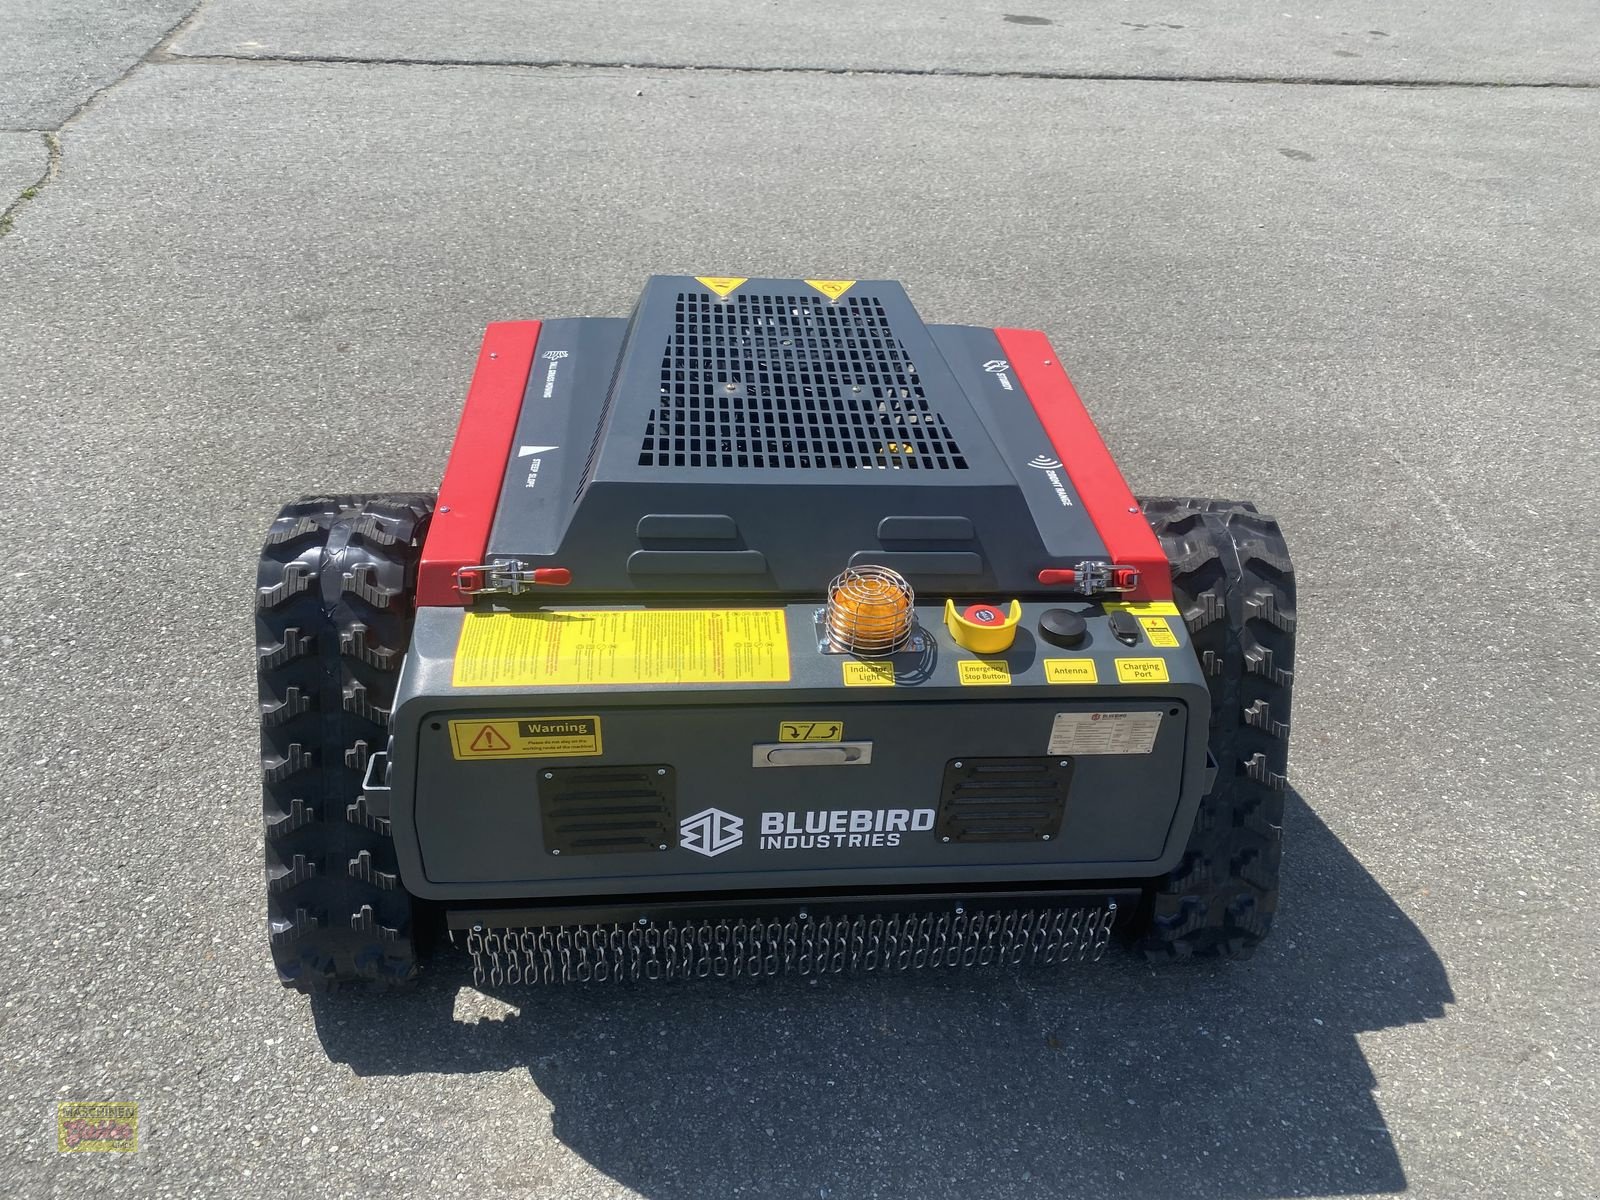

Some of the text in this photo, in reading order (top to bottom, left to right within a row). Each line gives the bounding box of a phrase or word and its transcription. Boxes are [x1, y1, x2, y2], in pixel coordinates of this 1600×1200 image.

[525, 458, 541, 488] STEEP SLOPE
[1055, 487, 1073, 506] RANGE
[850, 666, 887, 674] Indicator
[964, 666, 1004, 674] Emergency
[1054, 667, 1088, 675] Antenna
[1123, 663, 1160, 671] Charging
[859, 673, 881, 682] Light
[528, 722, 588, 734] Warning
[760, 808, 936, 835] BLUEBIRD
[760, 833, 900, 850] INDUSTRIES
